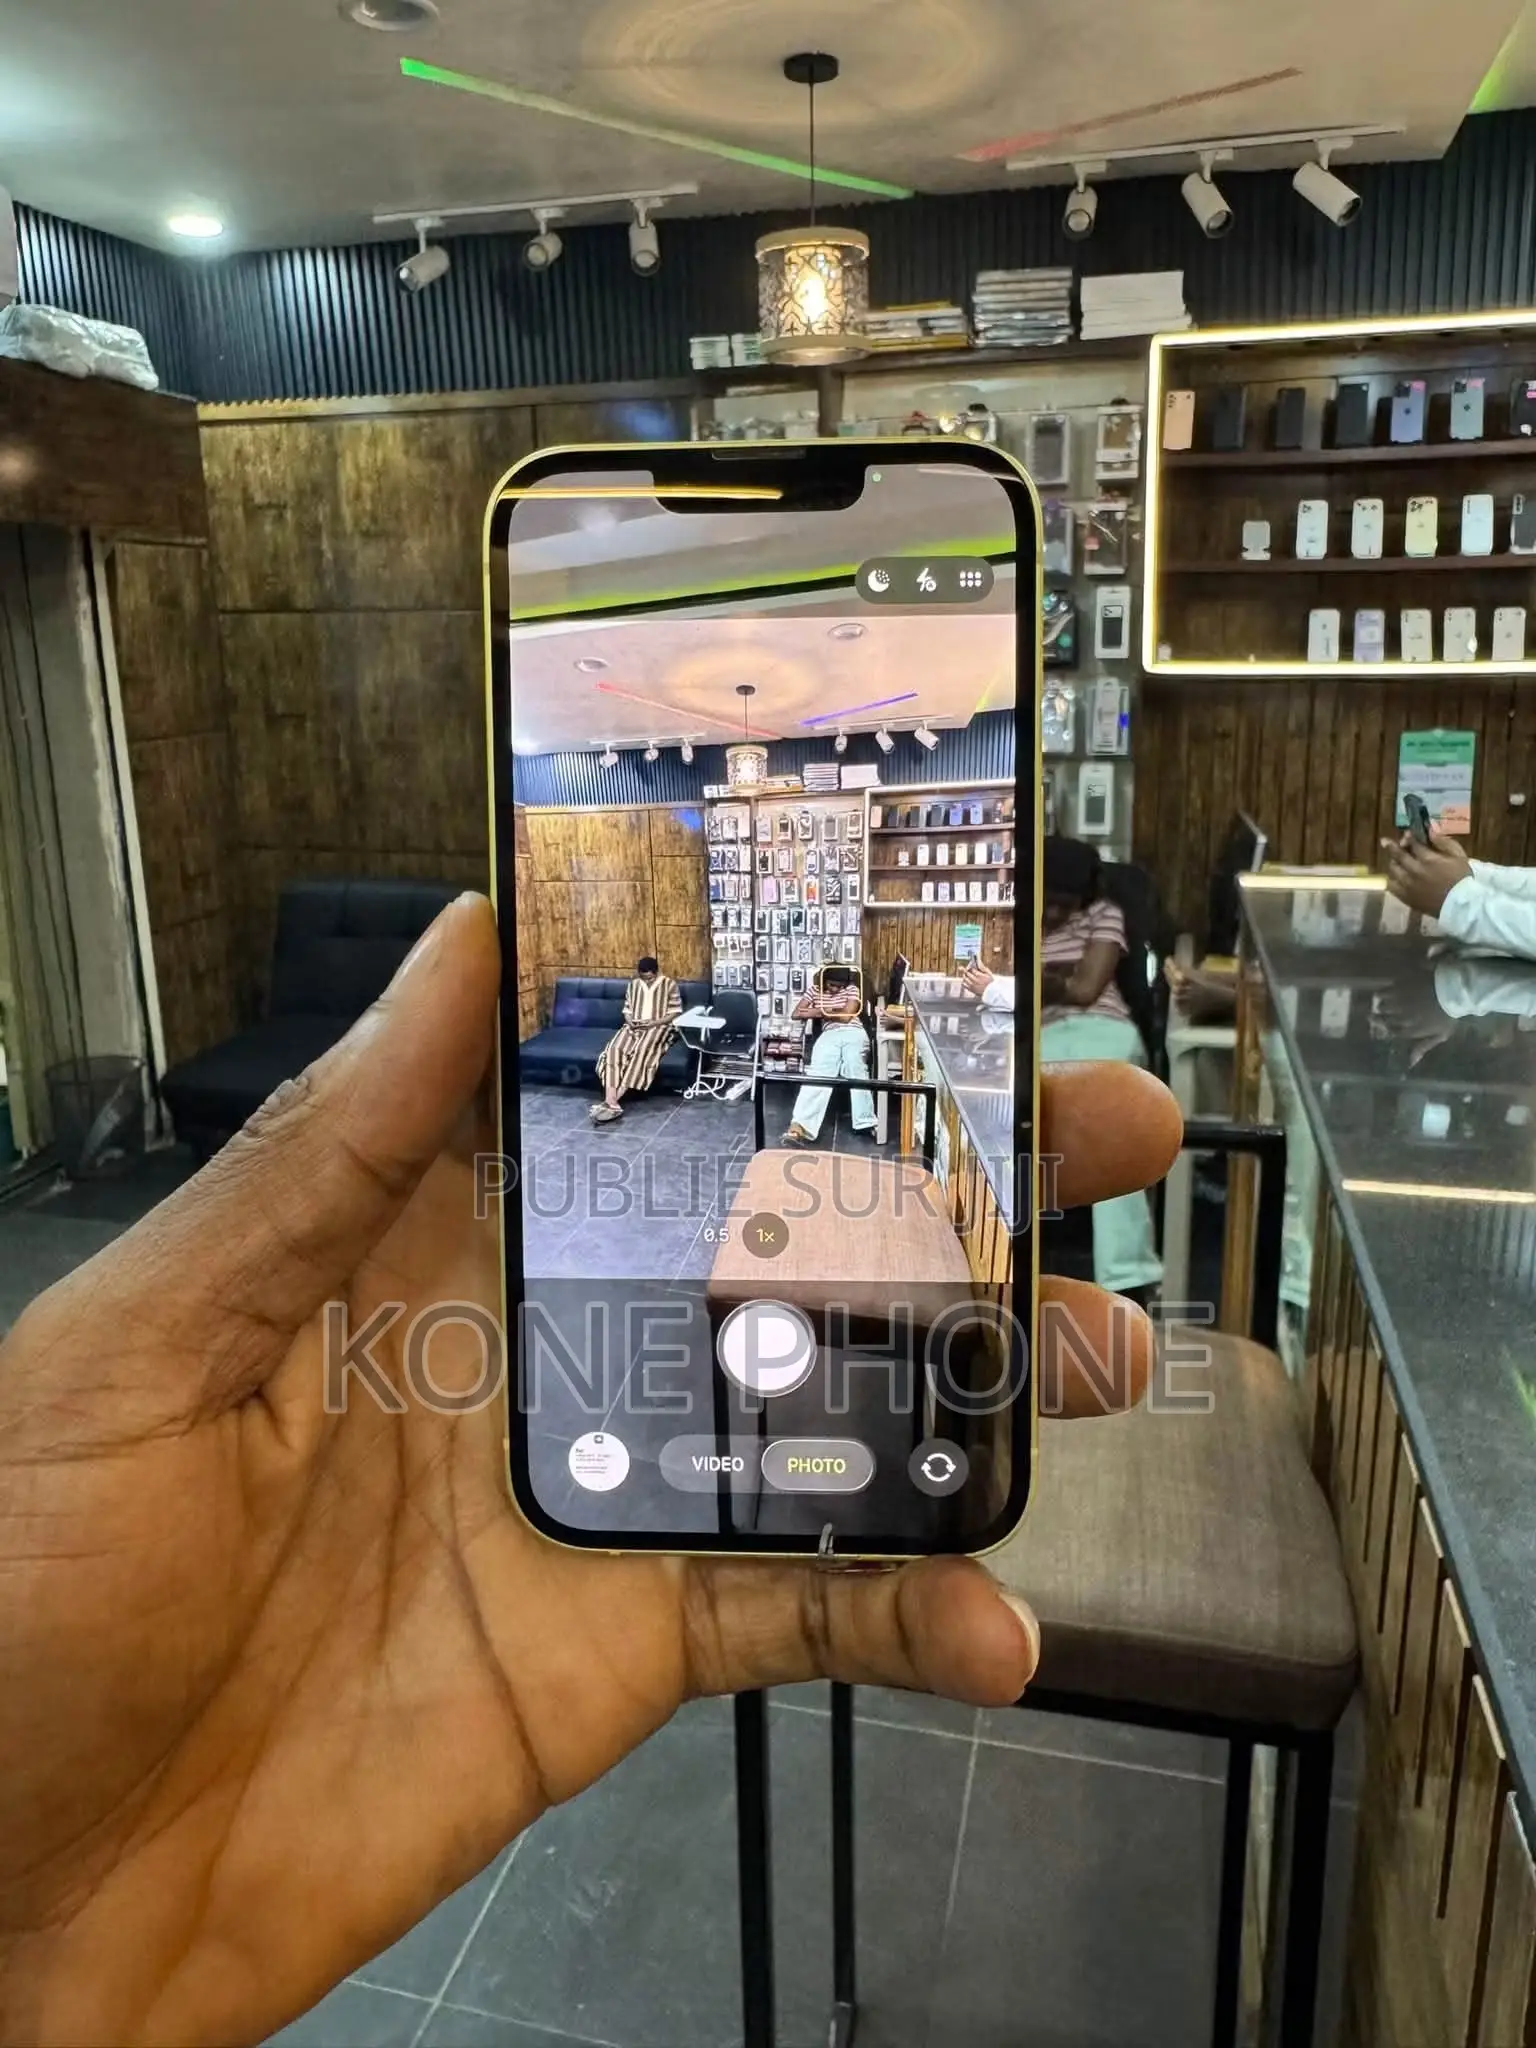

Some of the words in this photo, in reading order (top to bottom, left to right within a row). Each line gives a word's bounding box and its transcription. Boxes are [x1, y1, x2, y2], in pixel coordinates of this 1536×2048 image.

[703, 1228, 730, 1243] 0.5
[755, 1227, 776, 1243] 1x
[692, 1455, 745, 1472] VIDEO
[787, 1457, 847, 1474] PHOTO
